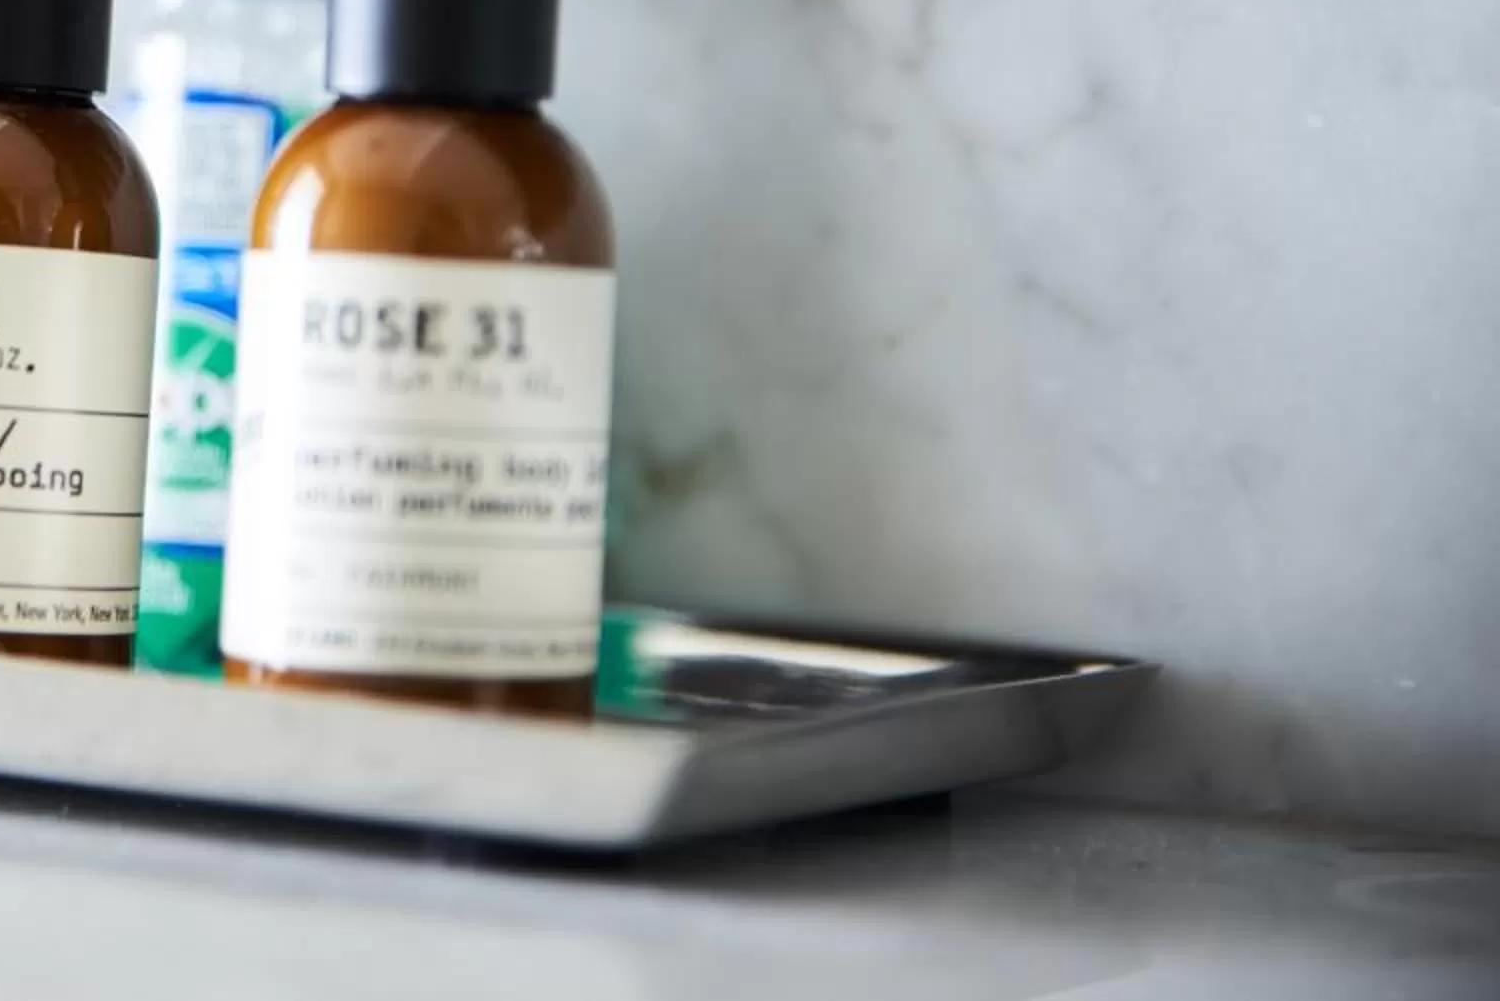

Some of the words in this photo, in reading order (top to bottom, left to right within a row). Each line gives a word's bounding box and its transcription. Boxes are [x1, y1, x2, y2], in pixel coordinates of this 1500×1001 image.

[303, 299, 448, 357] ROSE
[468, 303, 530, 361] 31
[15, 601, 47, 621] New
